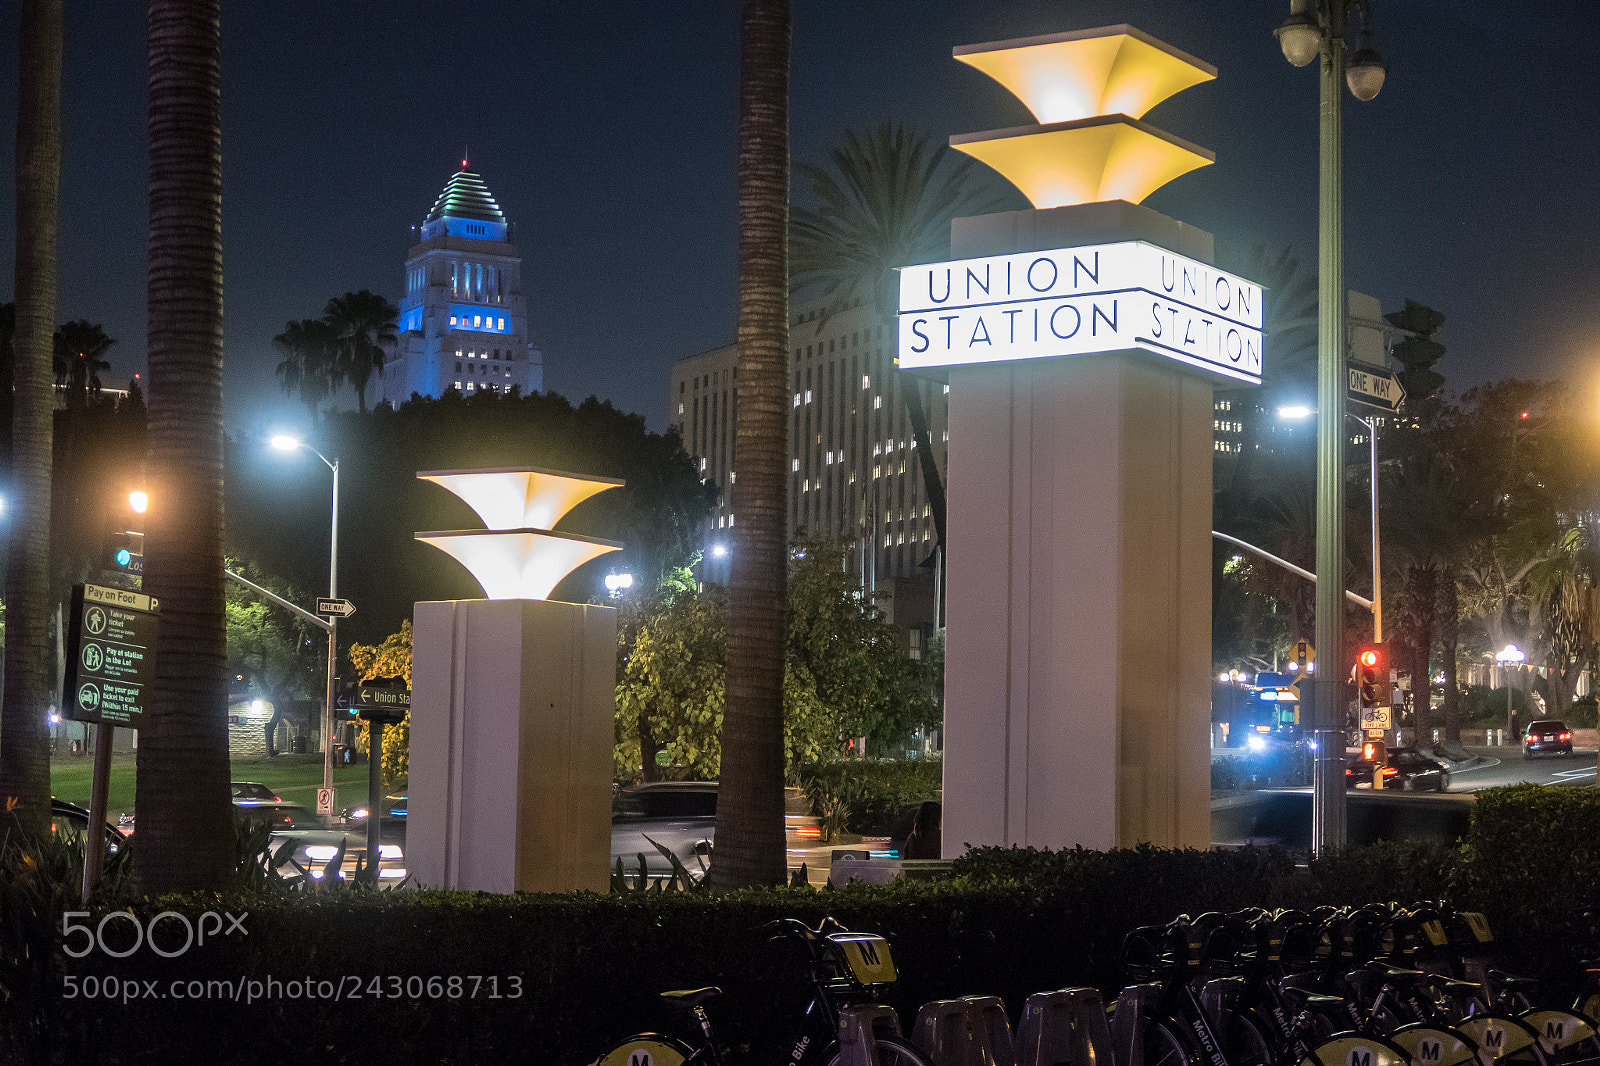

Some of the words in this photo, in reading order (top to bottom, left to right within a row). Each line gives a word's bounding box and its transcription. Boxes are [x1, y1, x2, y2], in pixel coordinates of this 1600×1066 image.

[929, 251, 1099, 303] UNION
[1161, 255, 1251, 317] UNION
[910, 299, 1118, 353] STATION
[1151, 302, 1259, 367] STATION
[1351, 371, 1368, 392] ONE
[1373, 377, 1391, 399] WAY
[88, 586, 104, 600] Pay
[105, 591, 116, 600] on
[118, 592, 136, 604] Foot
[151, 597, 159, 611] P
[105, 656, 112, 664] in
[112, 657, 122, 665] the
[122, 659, 132, 667] Lot
[106, 647, 117, 657] Pay
[124, 650, 144, 660] station
[102, 692, 118, 701] ticket
[118, 693, 125, 701] to
[124, 695, 135, 703] exit
[103, 683, 115, 692] Use
[114, 687, 127, 695] your
[127, 688, 139, 697] paid
[374, 691, 397, 703] Union
[399, 693, 411, 705] Sta
[856, 941, 881, 966] M
[1273, 1007, 1292, 1038] Metro
[1547, 1022, 1563, 1039] M
[1192, 1019, 1214, 1052] Metro
[1486, 1029, 1503, 1047] M
[791, 1034, 811, 1061] Bike
[1421, 1041, 1440, 1061] M
[632, 1055, 650, 1066] M
[1352, 1050, 1371, 1066] M
